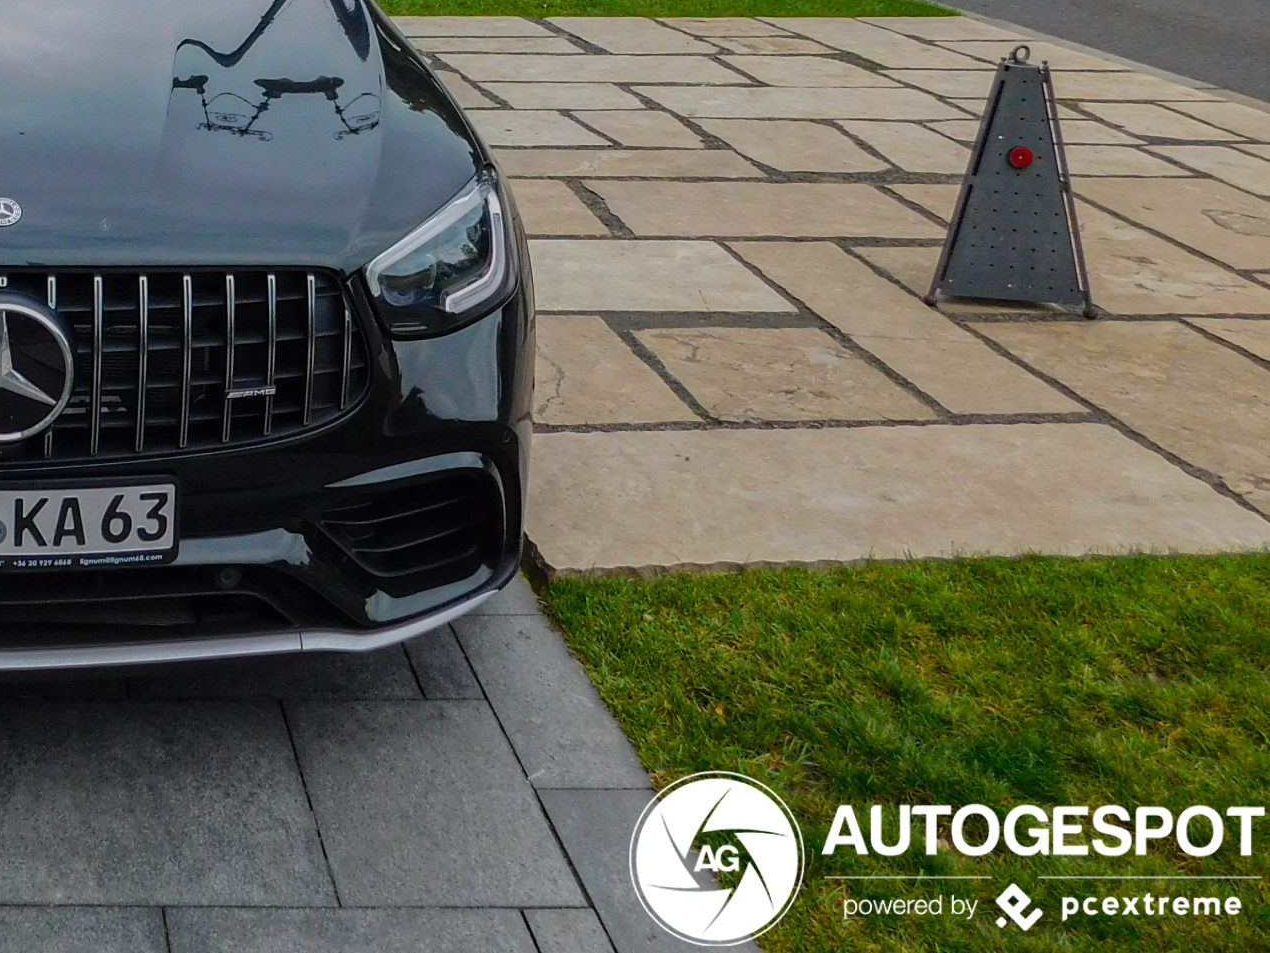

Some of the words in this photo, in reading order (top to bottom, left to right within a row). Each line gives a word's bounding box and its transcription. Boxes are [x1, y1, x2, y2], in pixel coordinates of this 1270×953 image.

[242, 388, 276, 398] AMG
[14, 496, 86, 547] KA
[101, 492, 168, 544] 63
